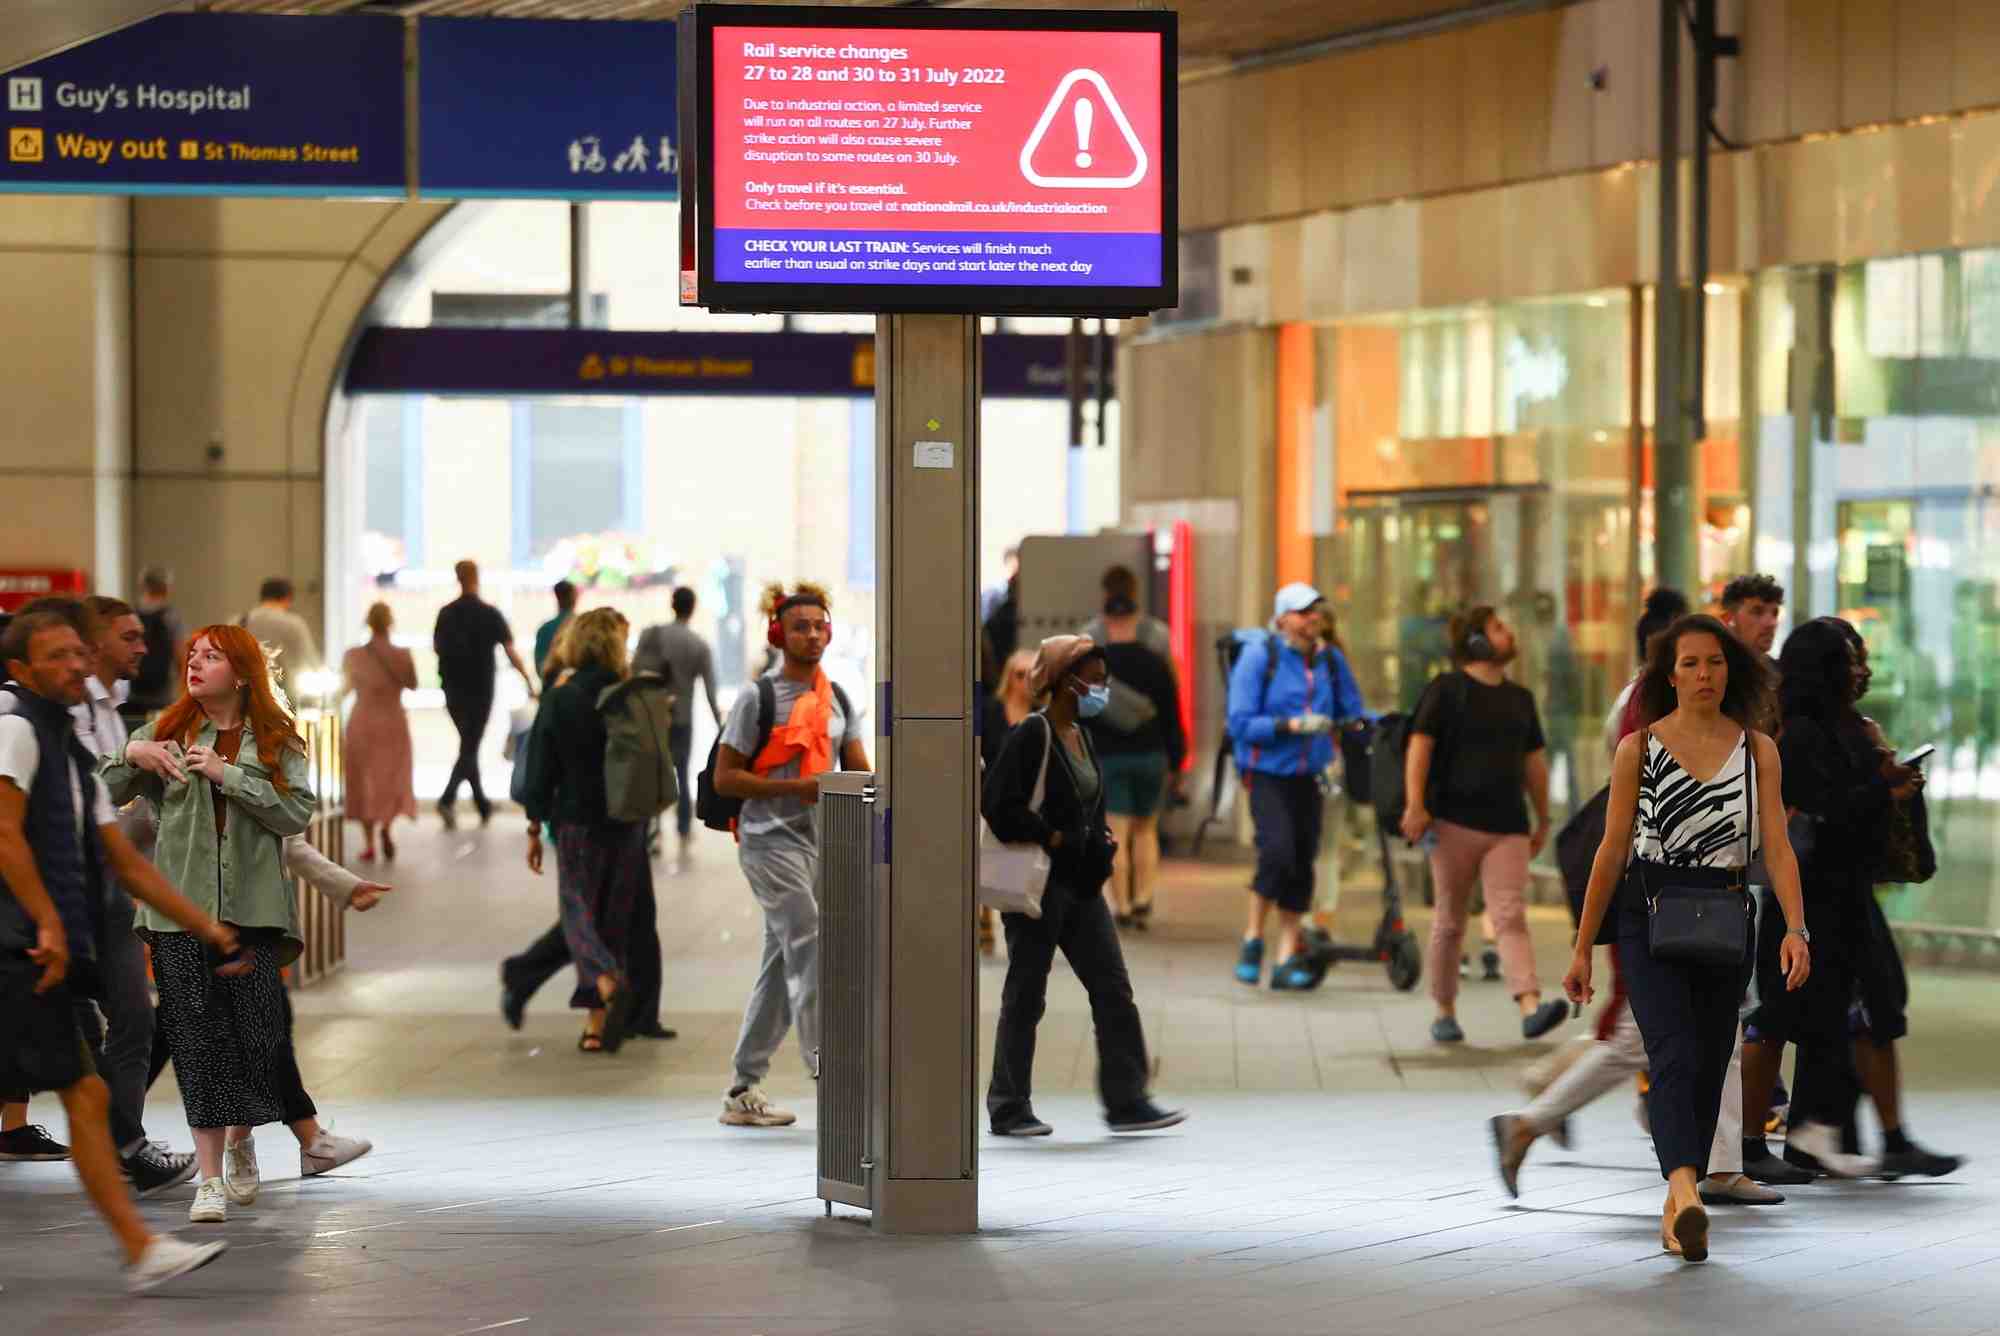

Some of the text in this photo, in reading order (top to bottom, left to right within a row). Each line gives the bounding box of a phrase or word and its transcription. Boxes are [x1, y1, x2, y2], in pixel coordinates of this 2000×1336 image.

[744, 43, 908, 63] Rail service changes
[744, 65, 1005, 86] 27 to 28 and 30 to 31 July 2022
[56, 83, 129, 112] Guy's
[137, 84, 250, 114] Hospital
[744, 98, 982, 112] Due to industrial action, a limited service
[744, 116, 972, 131] will run on all routes on 27 July. Further
[744, 133, 942, 146] strike action will also cause severe
[57, 133, 113, 163] Way
[121, 137, 167, 160] out
[204, 143, 224, 160] St
[230, 143, 297, 161] Thomas
[302, 143, 358, 162] Street
[744, 150, 959, 166] disruption to some routes on 30 July.
[745, 181, 907, 196] Only travel if it's essential.
[745, 198, 1108, 213] Check before you travel at nationalrail.co.uk/industrialaction
[744, 240, 1051, 254] CHECK YOUR LAST TRAIN: Services will finish much
[745, 258, 1092, 274] earlier than usual on strike days and start later the next day
